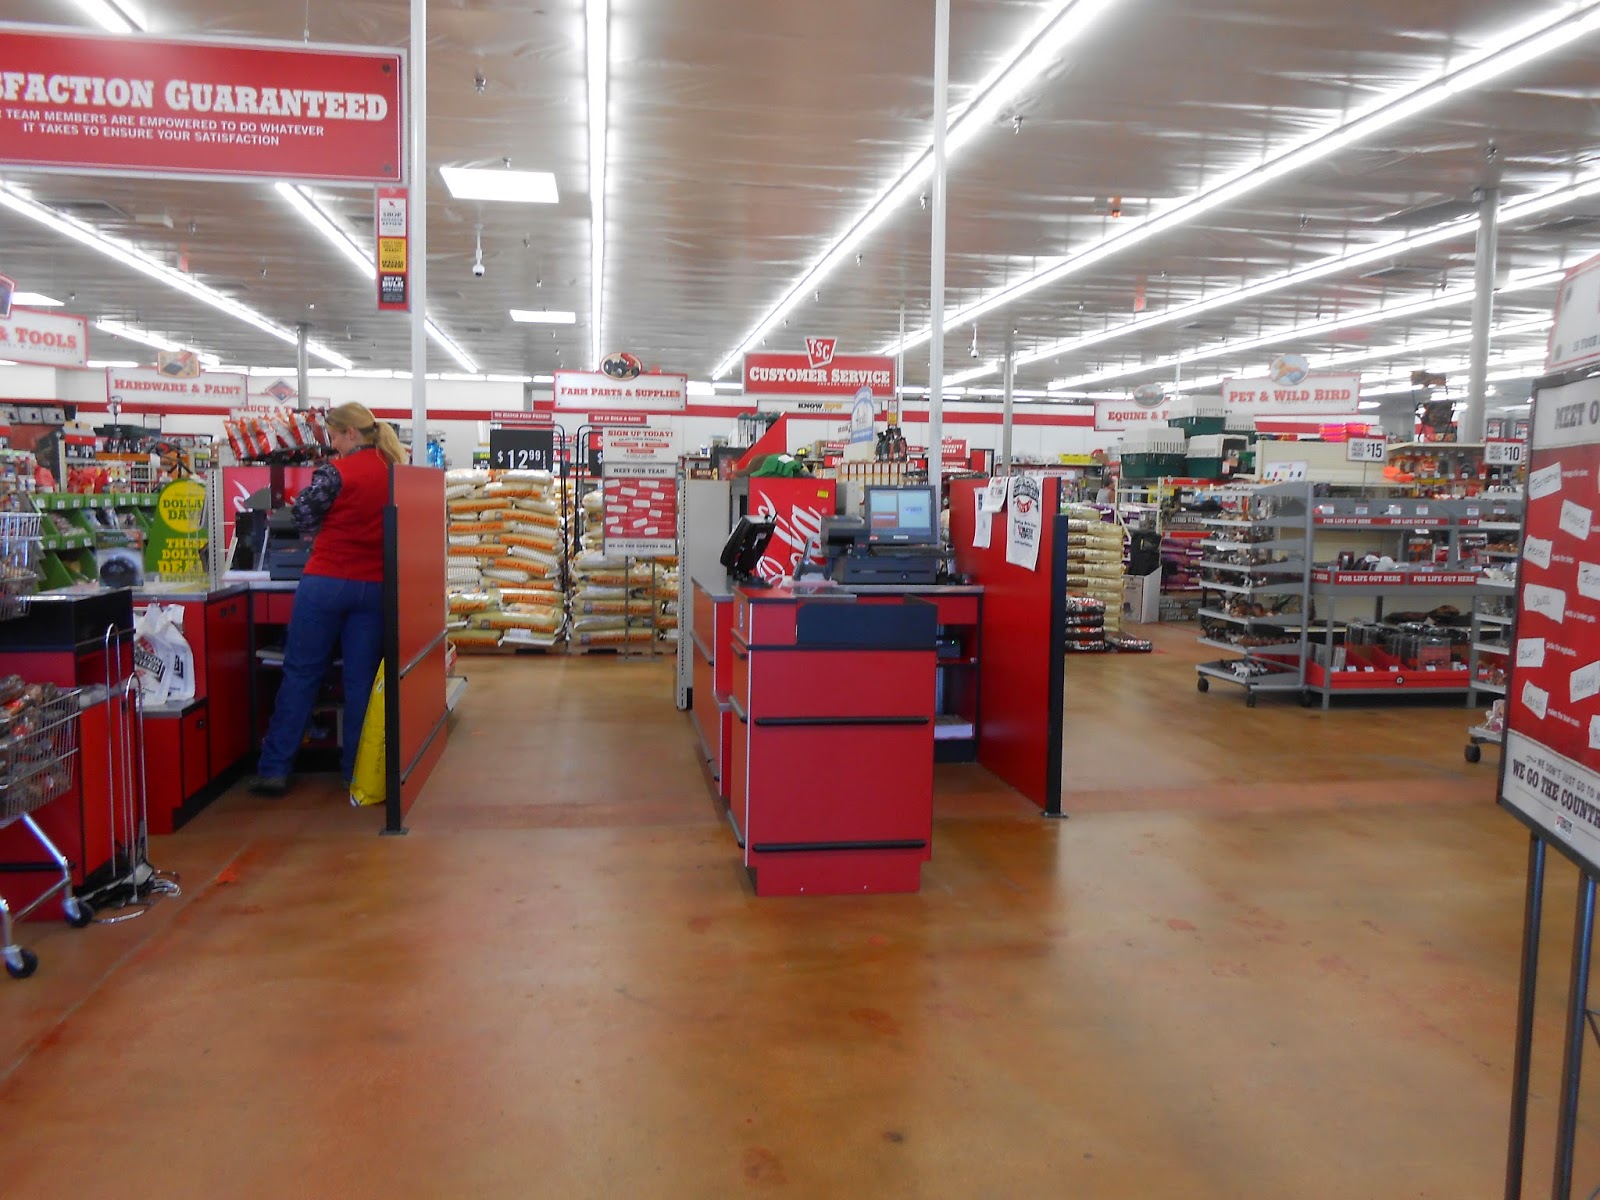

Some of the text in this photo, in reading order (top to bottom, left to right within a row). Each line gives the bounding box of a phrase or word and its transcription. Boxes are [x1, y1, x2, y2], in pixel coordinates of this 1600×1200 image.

[165, 79, 388, 121] GUARANTEED
[6, 109, 324, 136] TEAM MEMBERS ARE EMPOWERED TO DO WHATEVER
[23, 122, 279, 146] IT TAKES TO ENSURE YOUR SATISFACTION
[15, 327, 77, 349] TOOLS
[809, 338, 830, 360] TSC
[750, 367, 890, 383] CUSTOMER SERVICE
[114, 379, 187, 393] HARDWARE
[192, 384, 199, 393] &
[204, 384, 241, 396] PAINT
[561, 387, 588, 395] FARM
[592, 388, 620, 396] PARTS
[635, 388, 680, 397] SUPPLIES
[1229, 389, 1350, 403] PET & WILD BIRD
[1108, 411, 1147, 421] EQUINE
[1151, 411, 1158, 419] &
[1555, 401, 1586, 429] MEET
[1367, 443, 1382, 457] $15
[1504, 446, 1520, 460] $10
[162, 549, 200, 559] DOLL
[1513, 758, 1526, 780] WE
[1526, 767, 1539, 788] GO
[1541, 776, 1560, 801] THE
